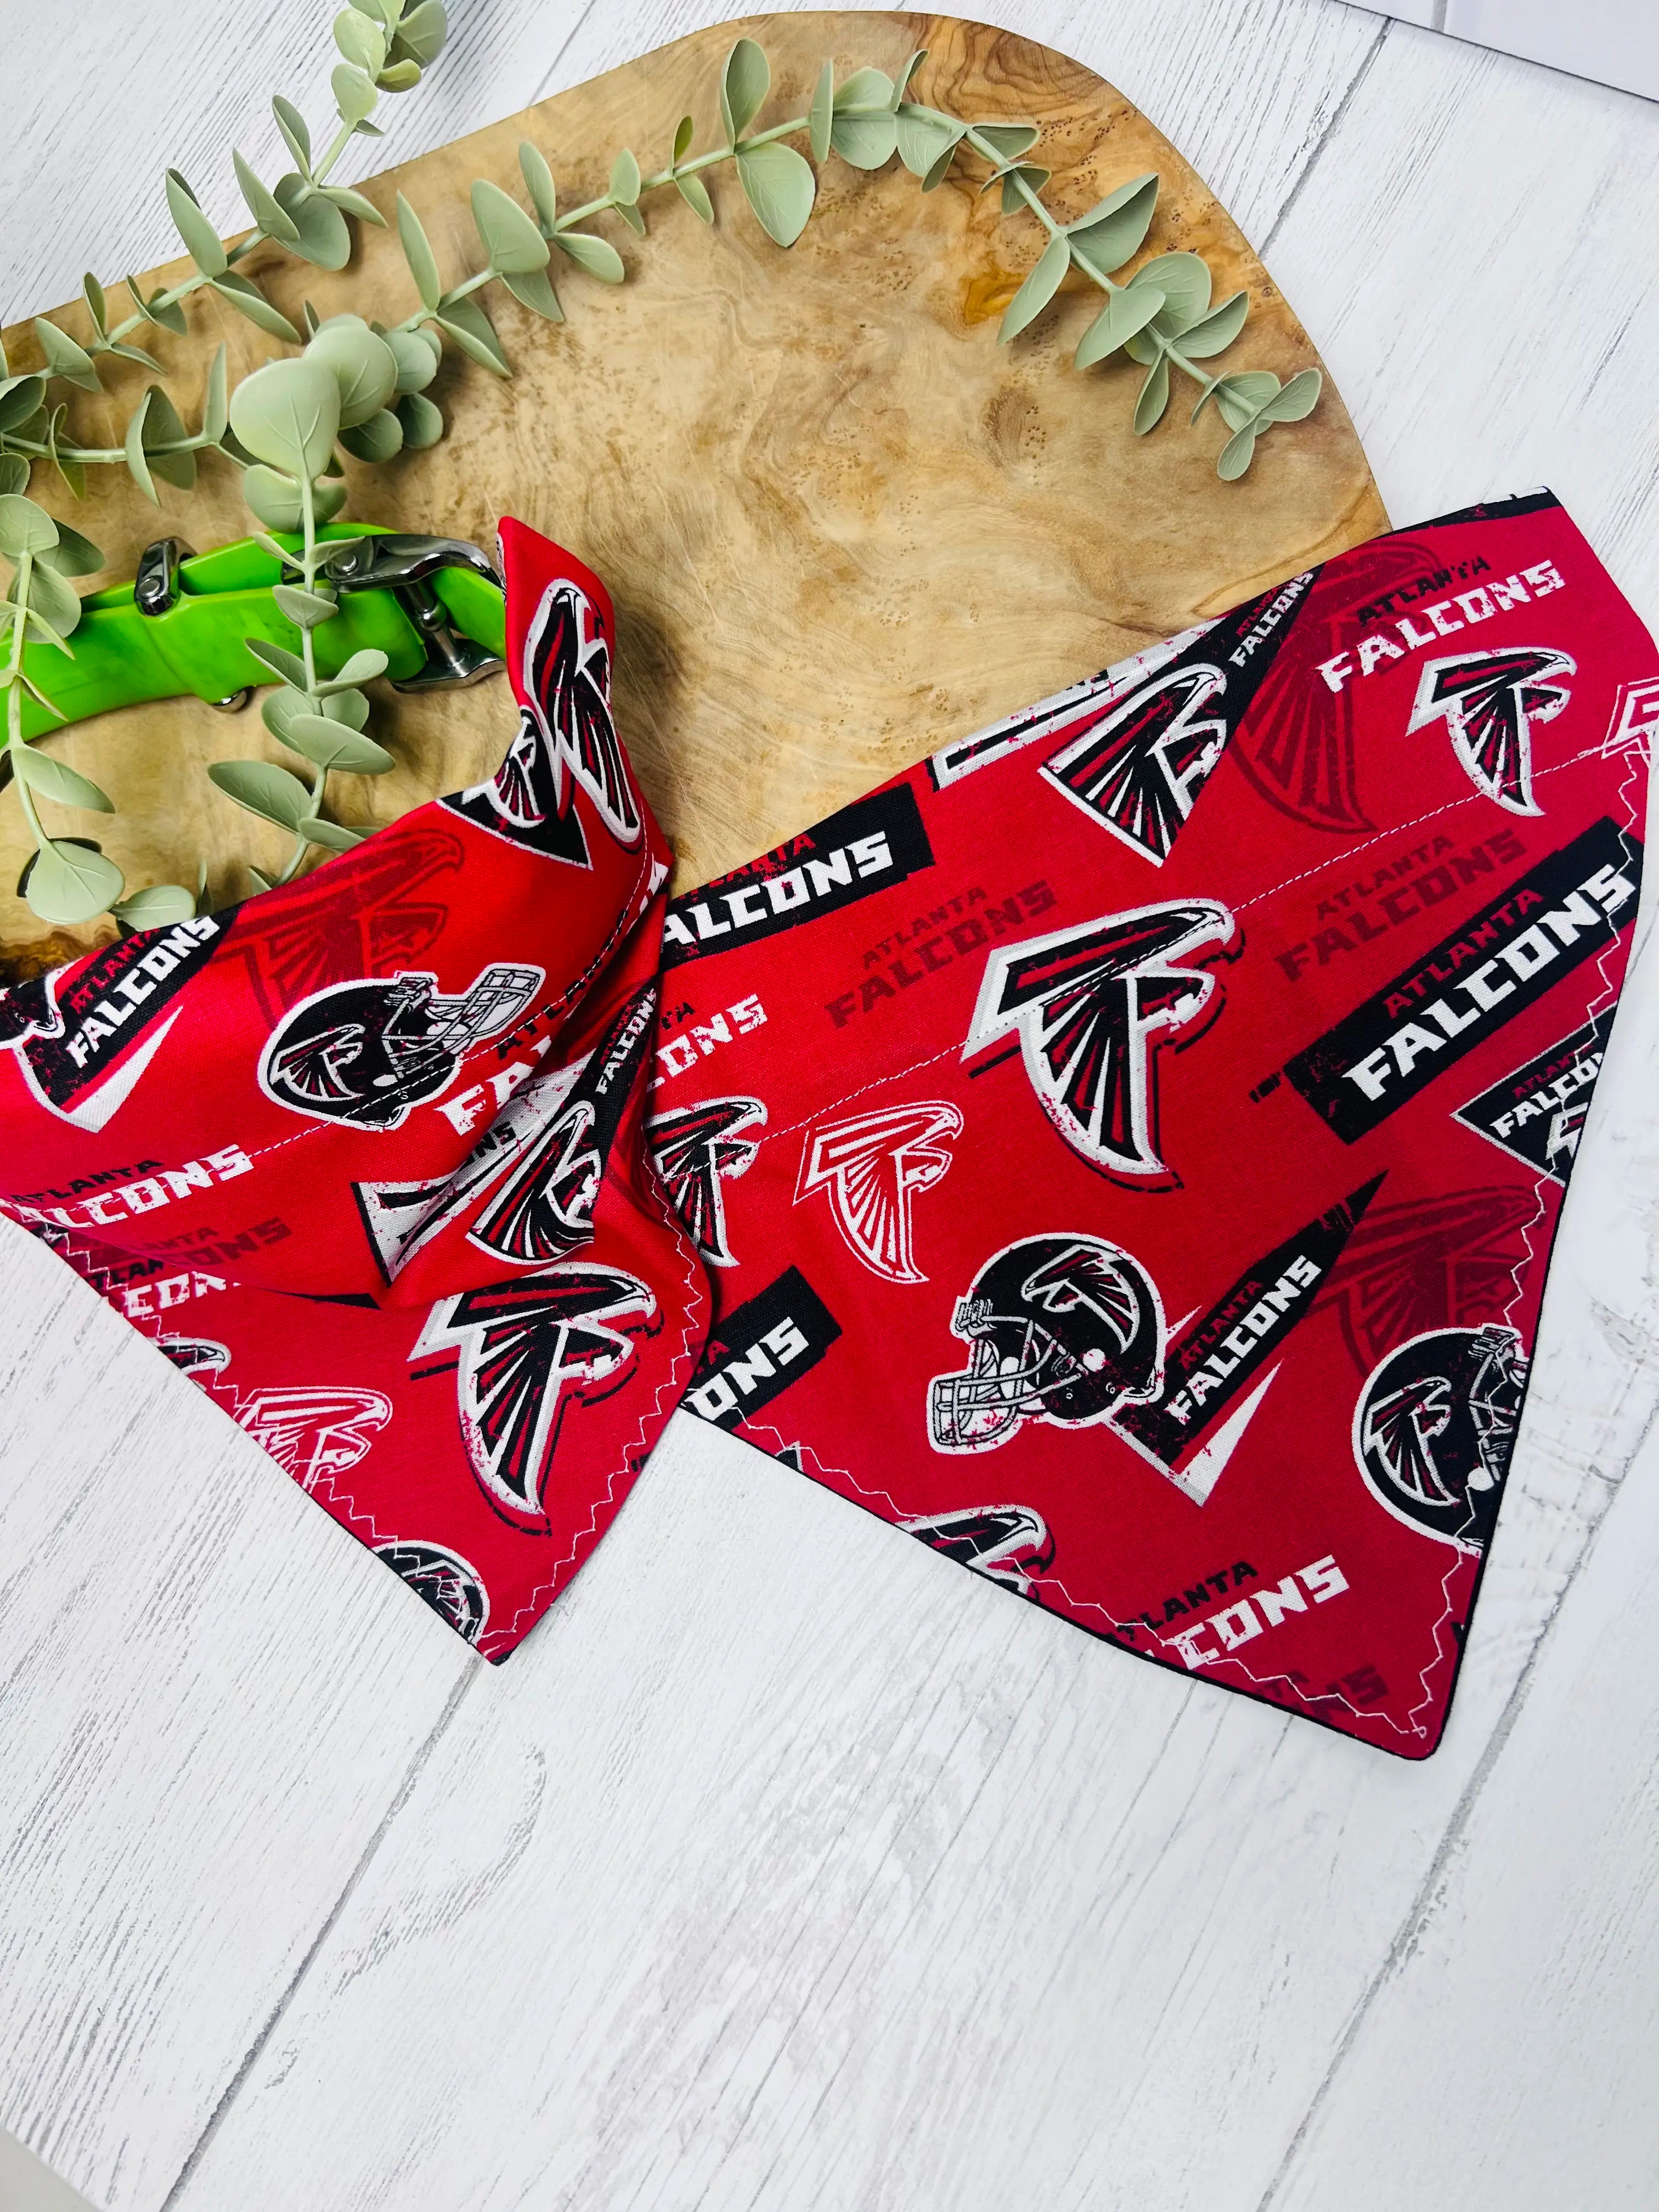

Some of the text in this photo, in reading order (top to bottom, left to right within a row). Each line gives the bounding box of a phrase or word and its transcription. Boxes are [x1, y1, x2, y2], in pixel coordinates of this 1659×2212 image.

[1228, 572, 1313, 667] FALCONS
[1316, 560, 1566, 693] FALCONS
[1356, 555, 1491, 628] ATLANTA
[863, 887, 987, 970] ATLANTA
[1273, 828, 1527, 983] FALCONS
[1317, 836, 1455, 922] ATLANTA
[65, 916, 220, 1068] FALCONS
[824, 879, 1058, 1029] FALCONS
[1342, 863, 1637, 1102] FALCONS
[1383, 888, 1545, 1018] ATLANTA
[9, 1159, 164, 1203] ATLANTA
[1163, 1254, 1322, 1426] FALCONS
[1180, 1281, 1263, 1370] ATLANTA
